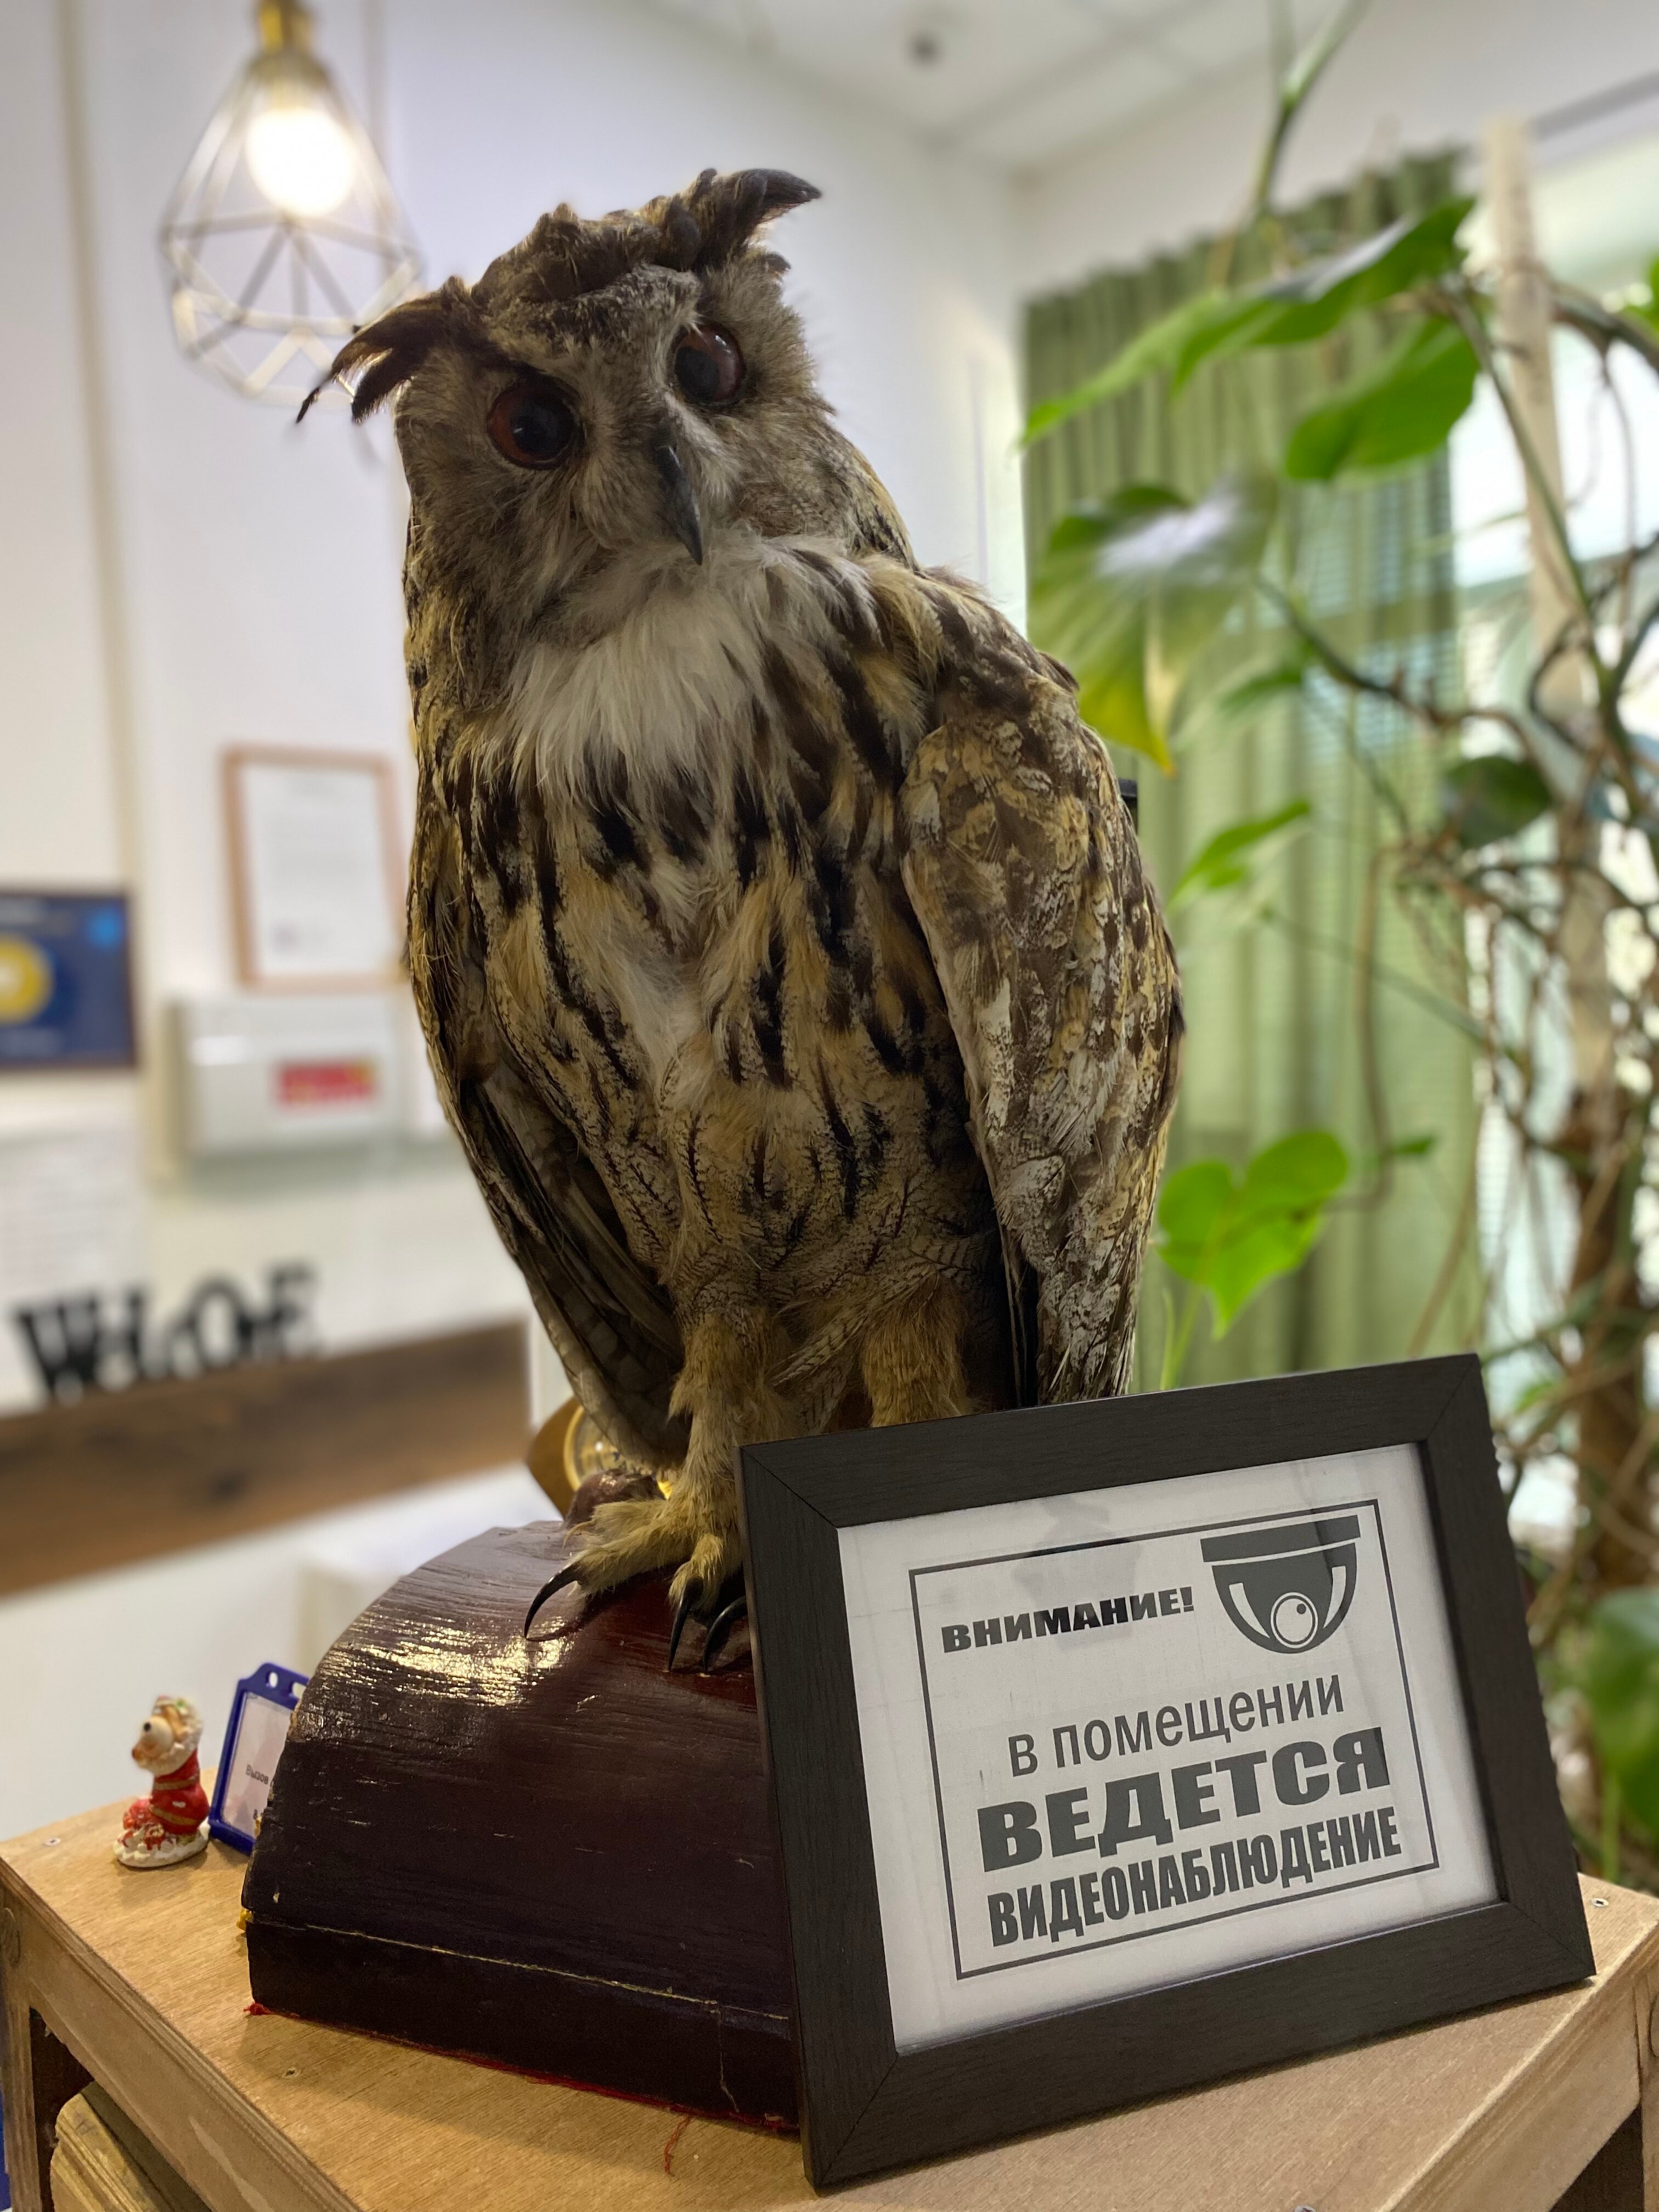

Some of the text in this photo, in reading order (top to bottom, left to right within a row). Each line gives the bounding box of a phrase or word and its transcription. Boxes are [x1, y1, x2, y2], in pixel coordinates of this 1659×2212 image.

[941, 1586, 1194, 1654] ВНИМАНИЕ!
[1052, 1674, 1344, 1769] помещении
[977, 1726, 1391, 1873] ВЕДЕТСЯ
[987, 1806, 1402, 1948] ВИДЕОНАБЛЮДЕНИЕ
